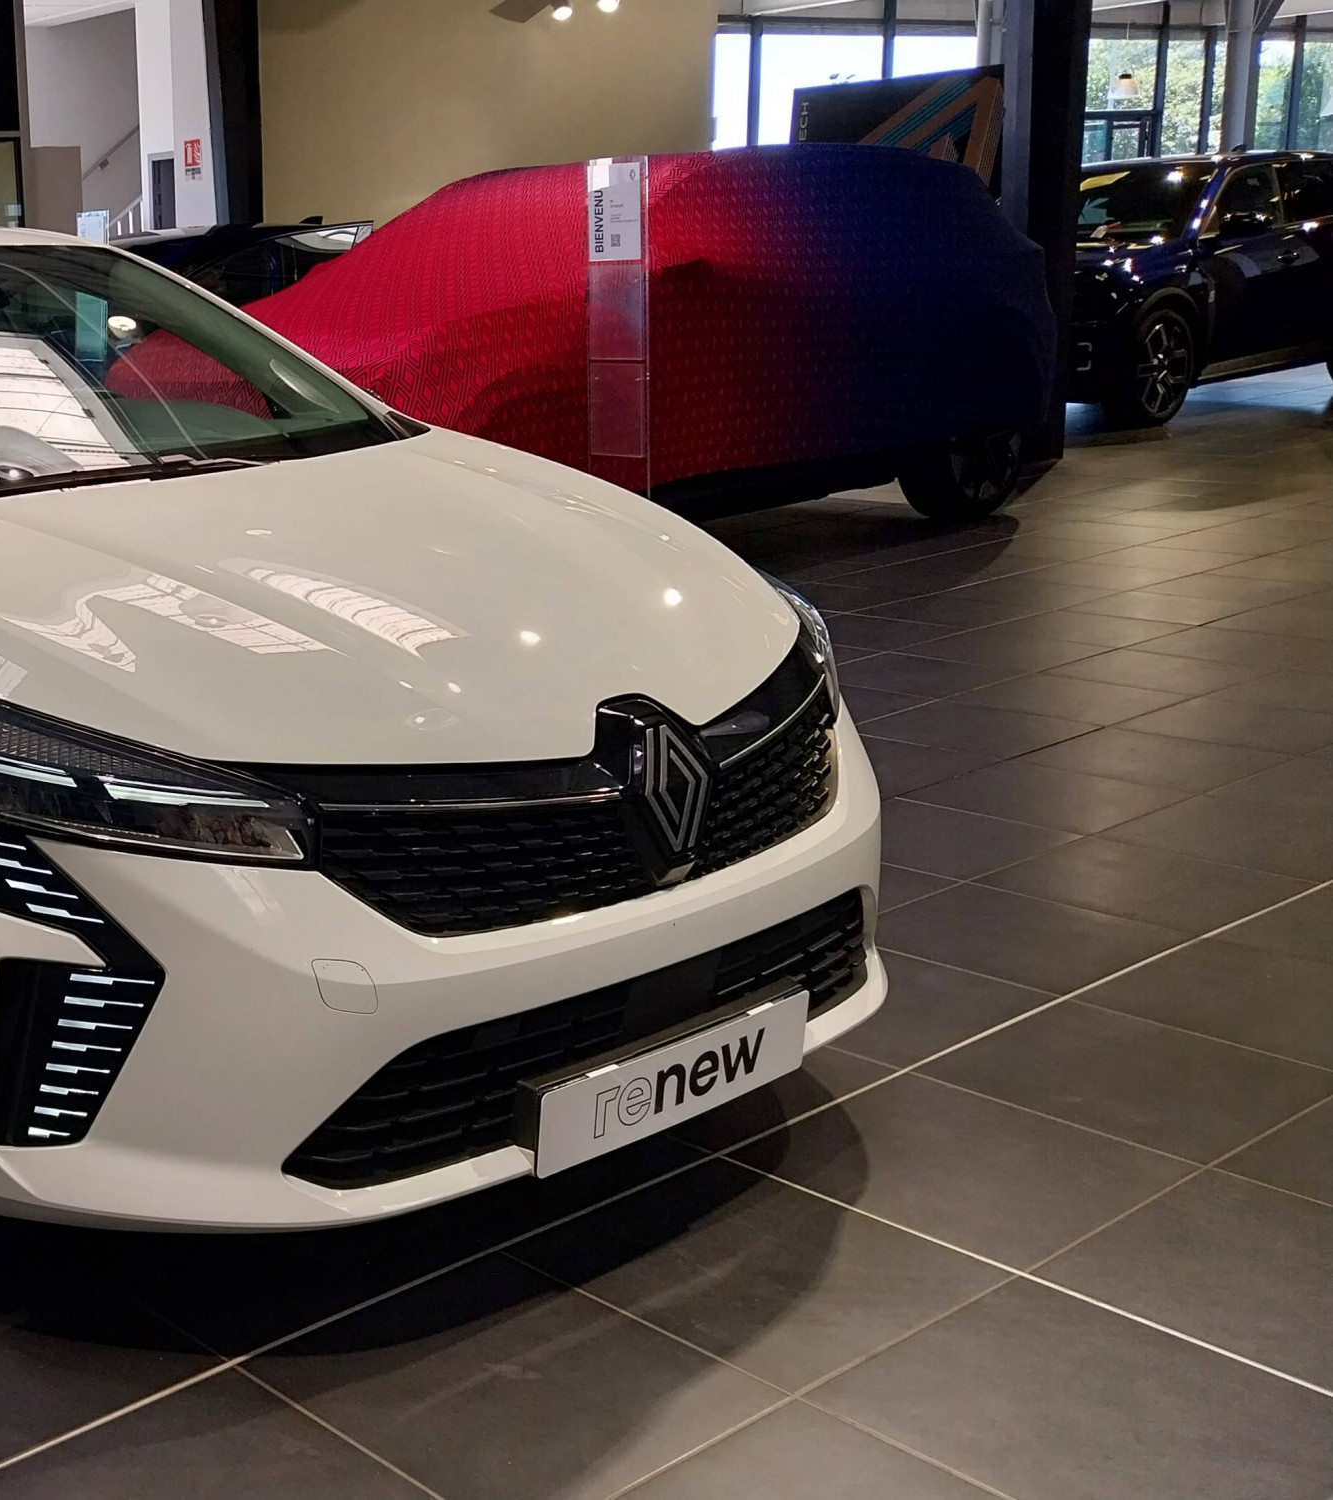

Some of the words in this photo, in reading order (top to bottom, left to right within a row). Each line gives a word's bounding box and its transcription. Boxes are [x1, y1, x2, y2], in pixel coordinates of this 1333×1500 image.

[798, 102, 809, 141] ECH
[594, 190, 604, 253] BIENVENU
[593, 1027, 765, 1139] renew
